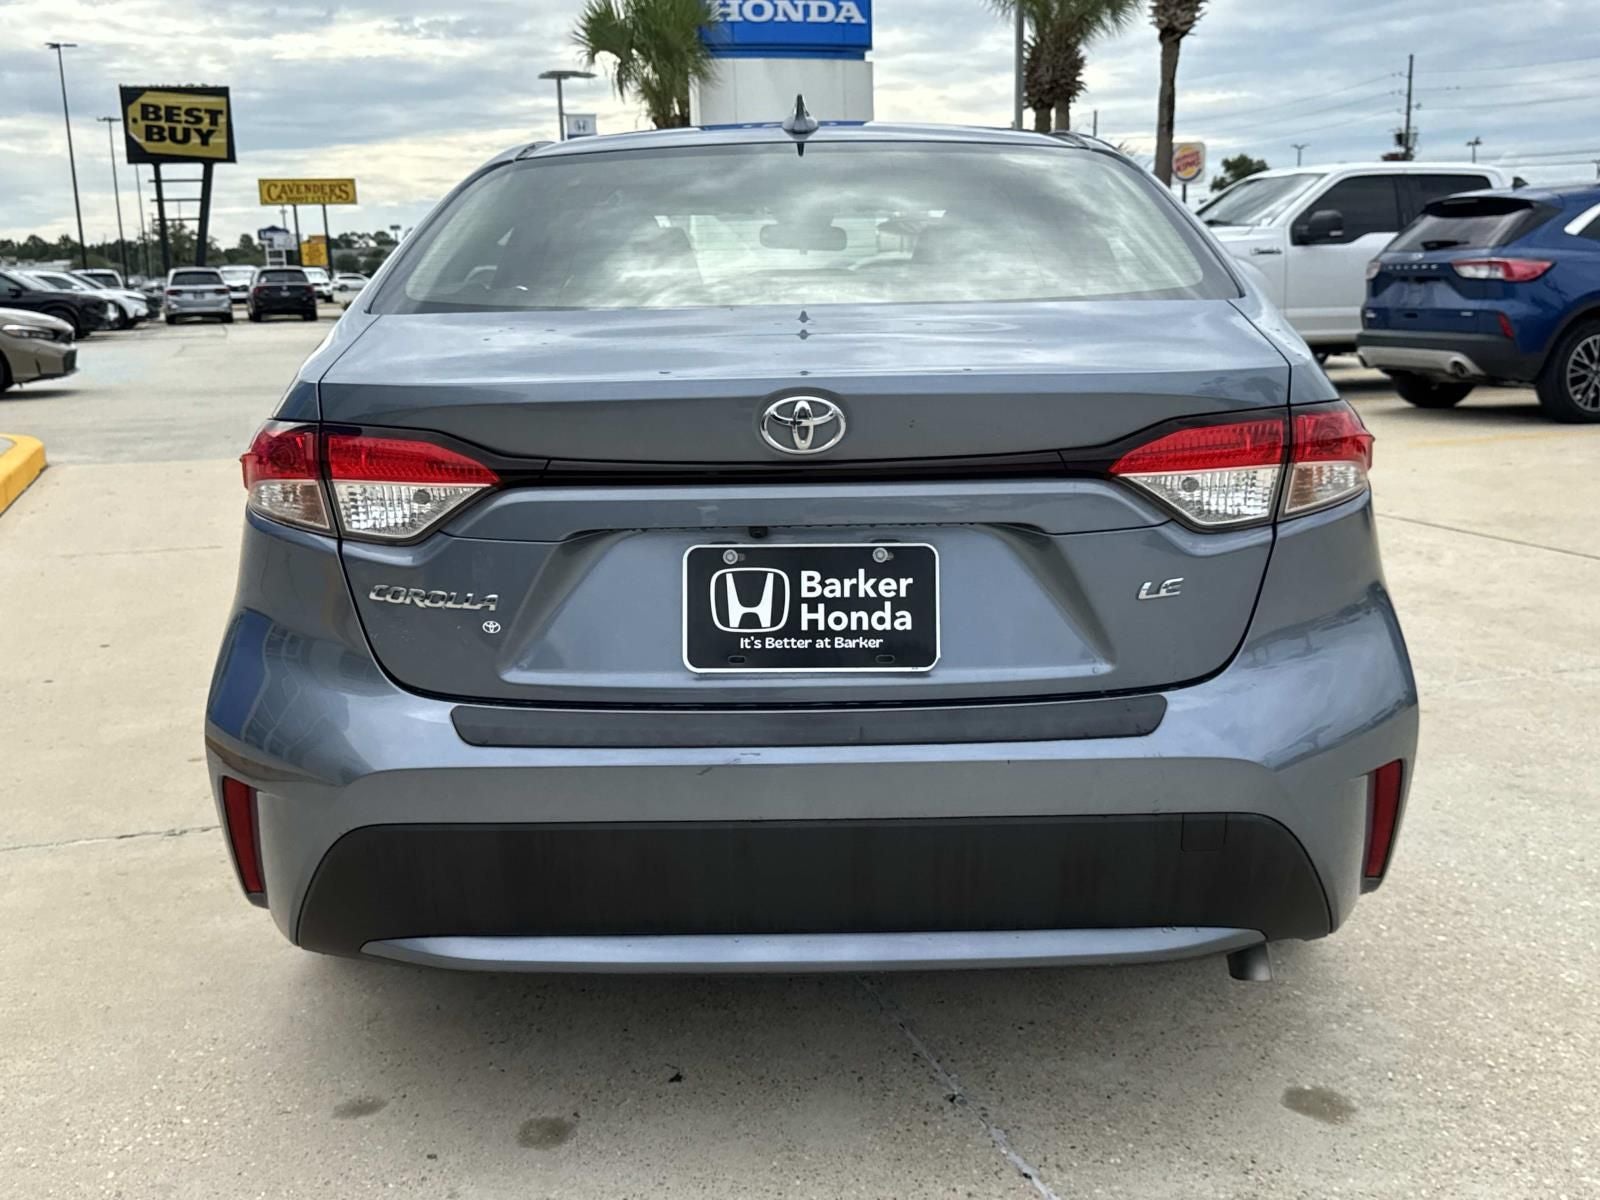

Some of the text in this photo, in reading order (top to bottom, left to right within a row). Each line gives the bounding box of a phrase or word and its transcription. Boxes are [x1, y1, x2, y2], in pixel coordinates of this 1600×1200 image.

[708, 0, 867, 24] HONDA
[140, 103, 224, 127] BEST
[144, 124, 217, 147] BUY
[800, 568, 914, 598] Barker
[1137, 577, 1185, 600] LE
[368, 584, 499, 611] COROLLA
[800, 601, 913, 631] Honda
[740, 636, 884, 649] It's Better at Barker
